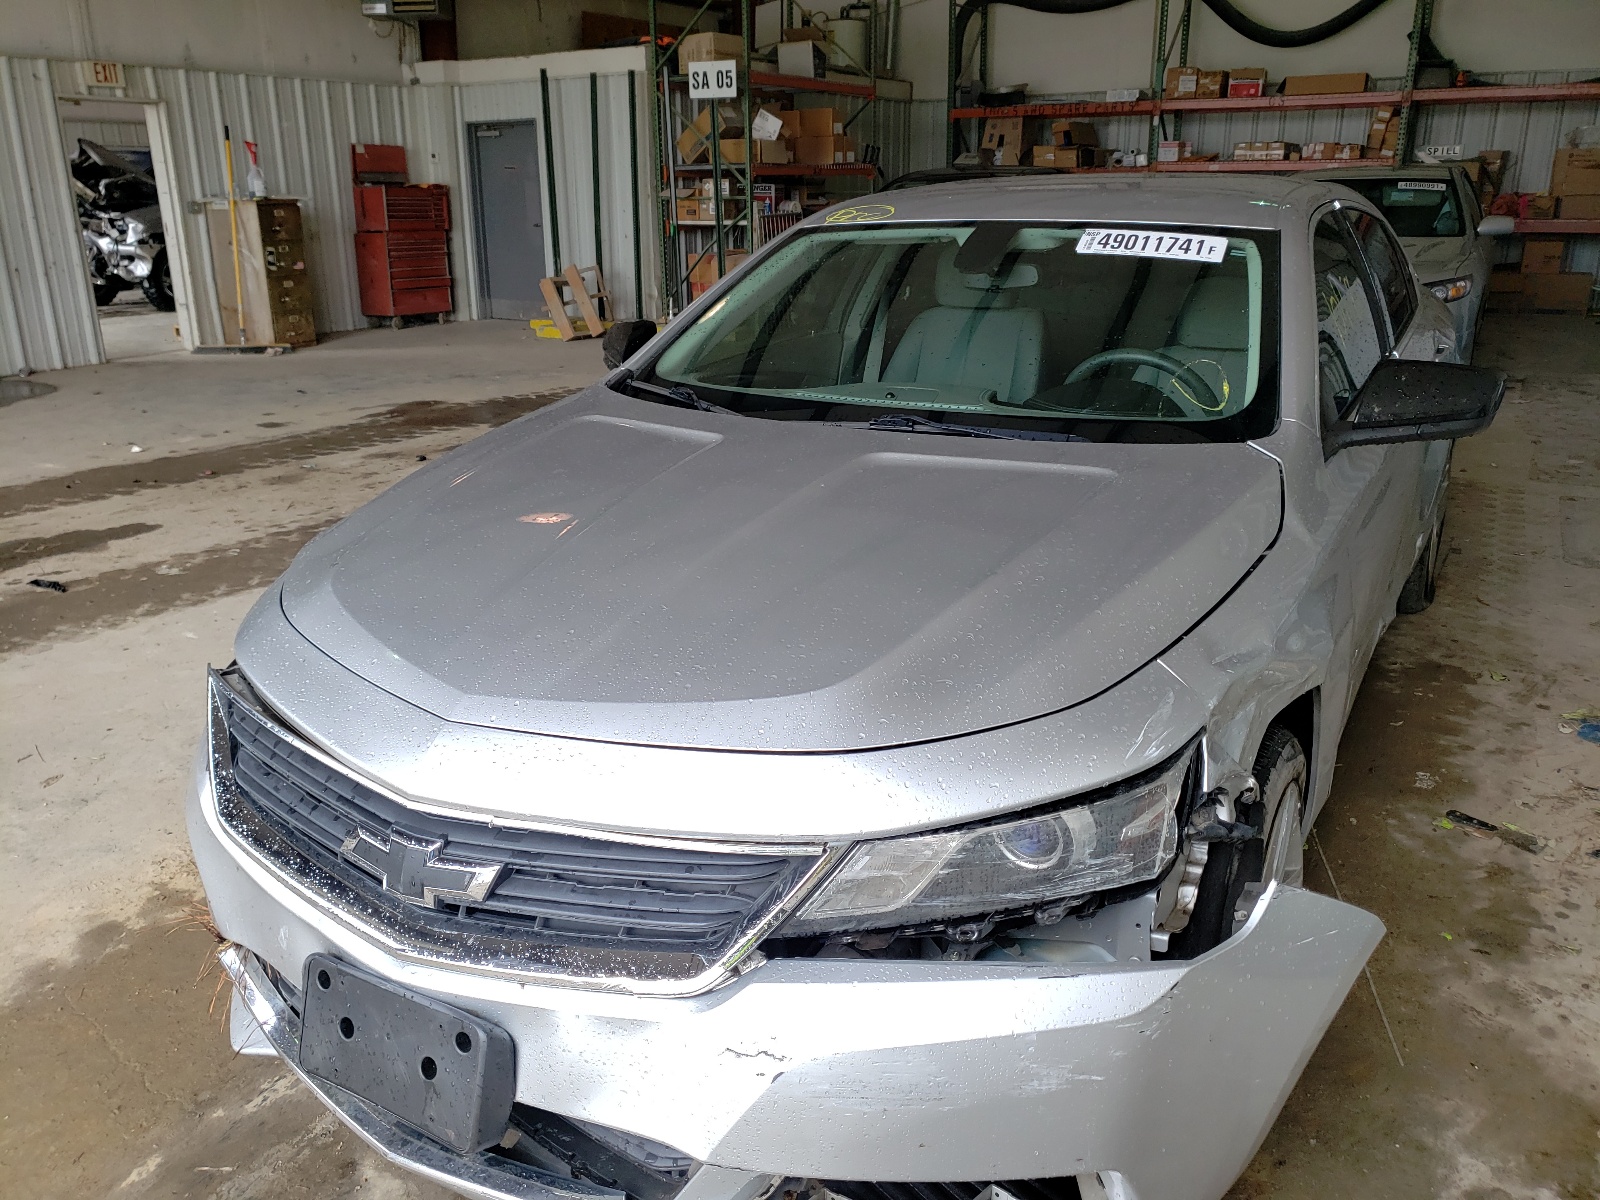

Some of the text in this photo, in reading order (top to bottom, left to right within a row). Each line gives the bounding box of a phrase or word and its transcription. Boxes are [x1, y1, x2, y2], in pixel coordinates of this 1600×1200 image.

[93, 62, 119, 83] EXIT
[692, 69, 733, 90] SA 05
[1427, 147, 1459, 156] SPILL
[1097, 232, 1206, 256] 49011741
[1208, 245, 1217, 255] F
